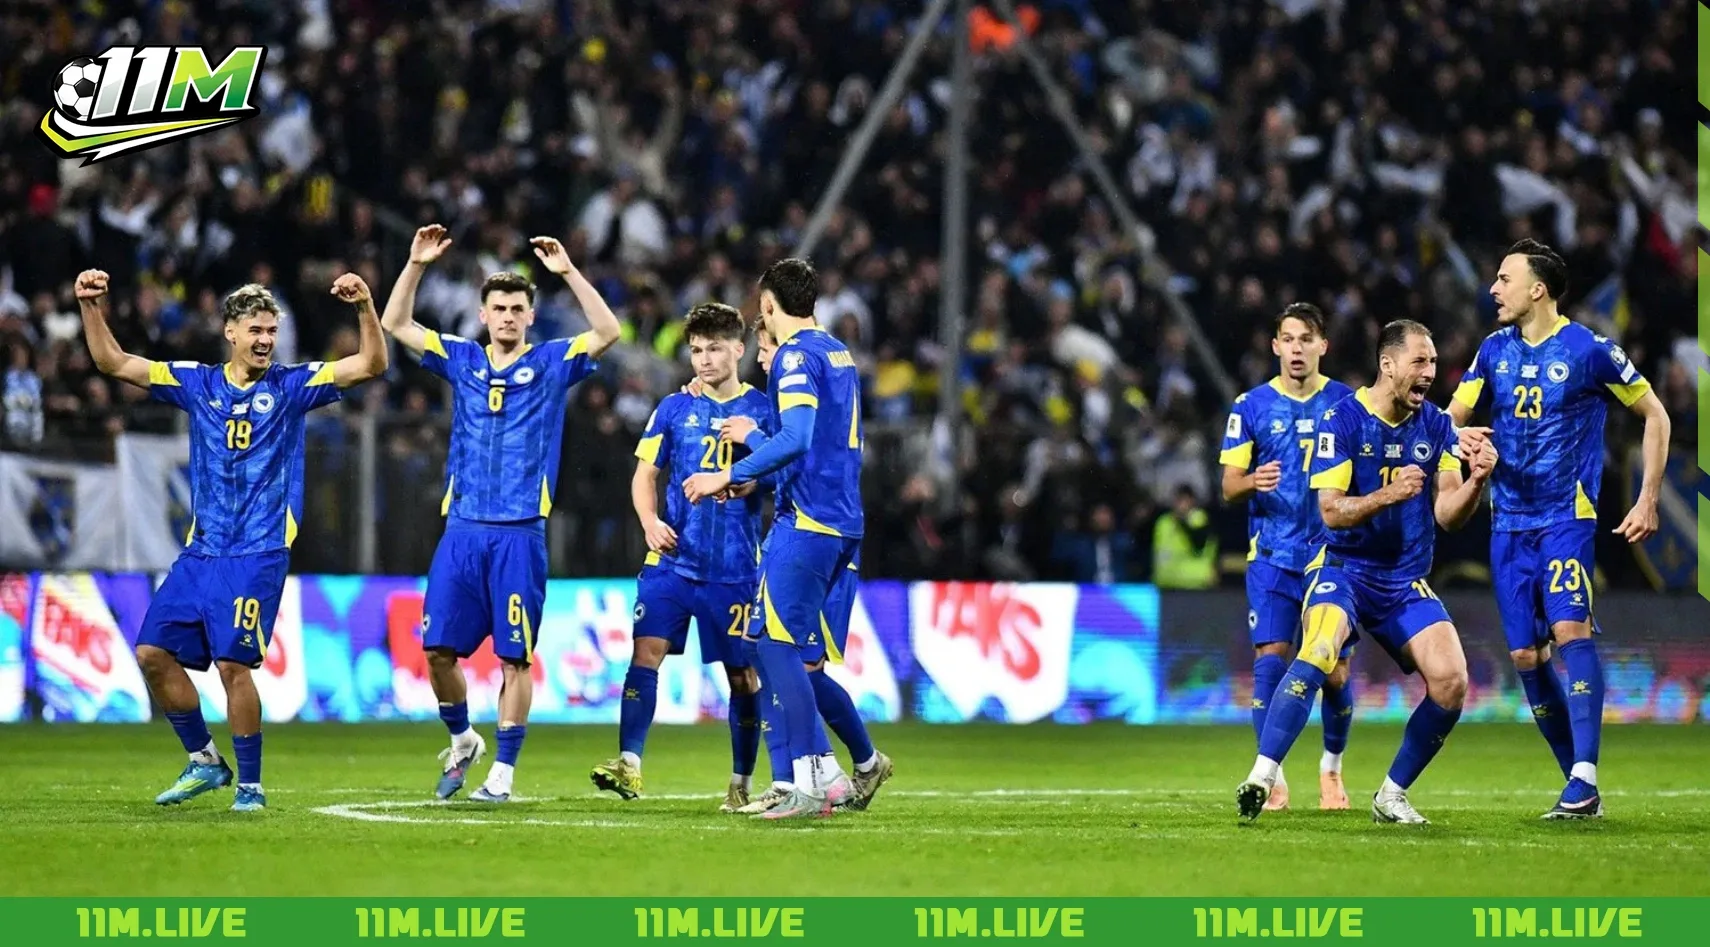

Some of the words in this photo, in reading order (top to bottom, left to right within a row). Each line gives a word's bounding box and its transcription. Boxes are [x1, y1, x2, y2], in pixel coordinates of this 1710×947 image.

[489, 387, 505, 412] 6
[1513, 385, 1543, 419] 23
[225, 419, 252, 449] 19
[700, 435, 733, 470] 20
[1299, 438, 1315, 472] 7
[1548, 558, 1581, 593] 23
[233, 596, 260, 631] 19
[508, 593, 522, 626] 6
